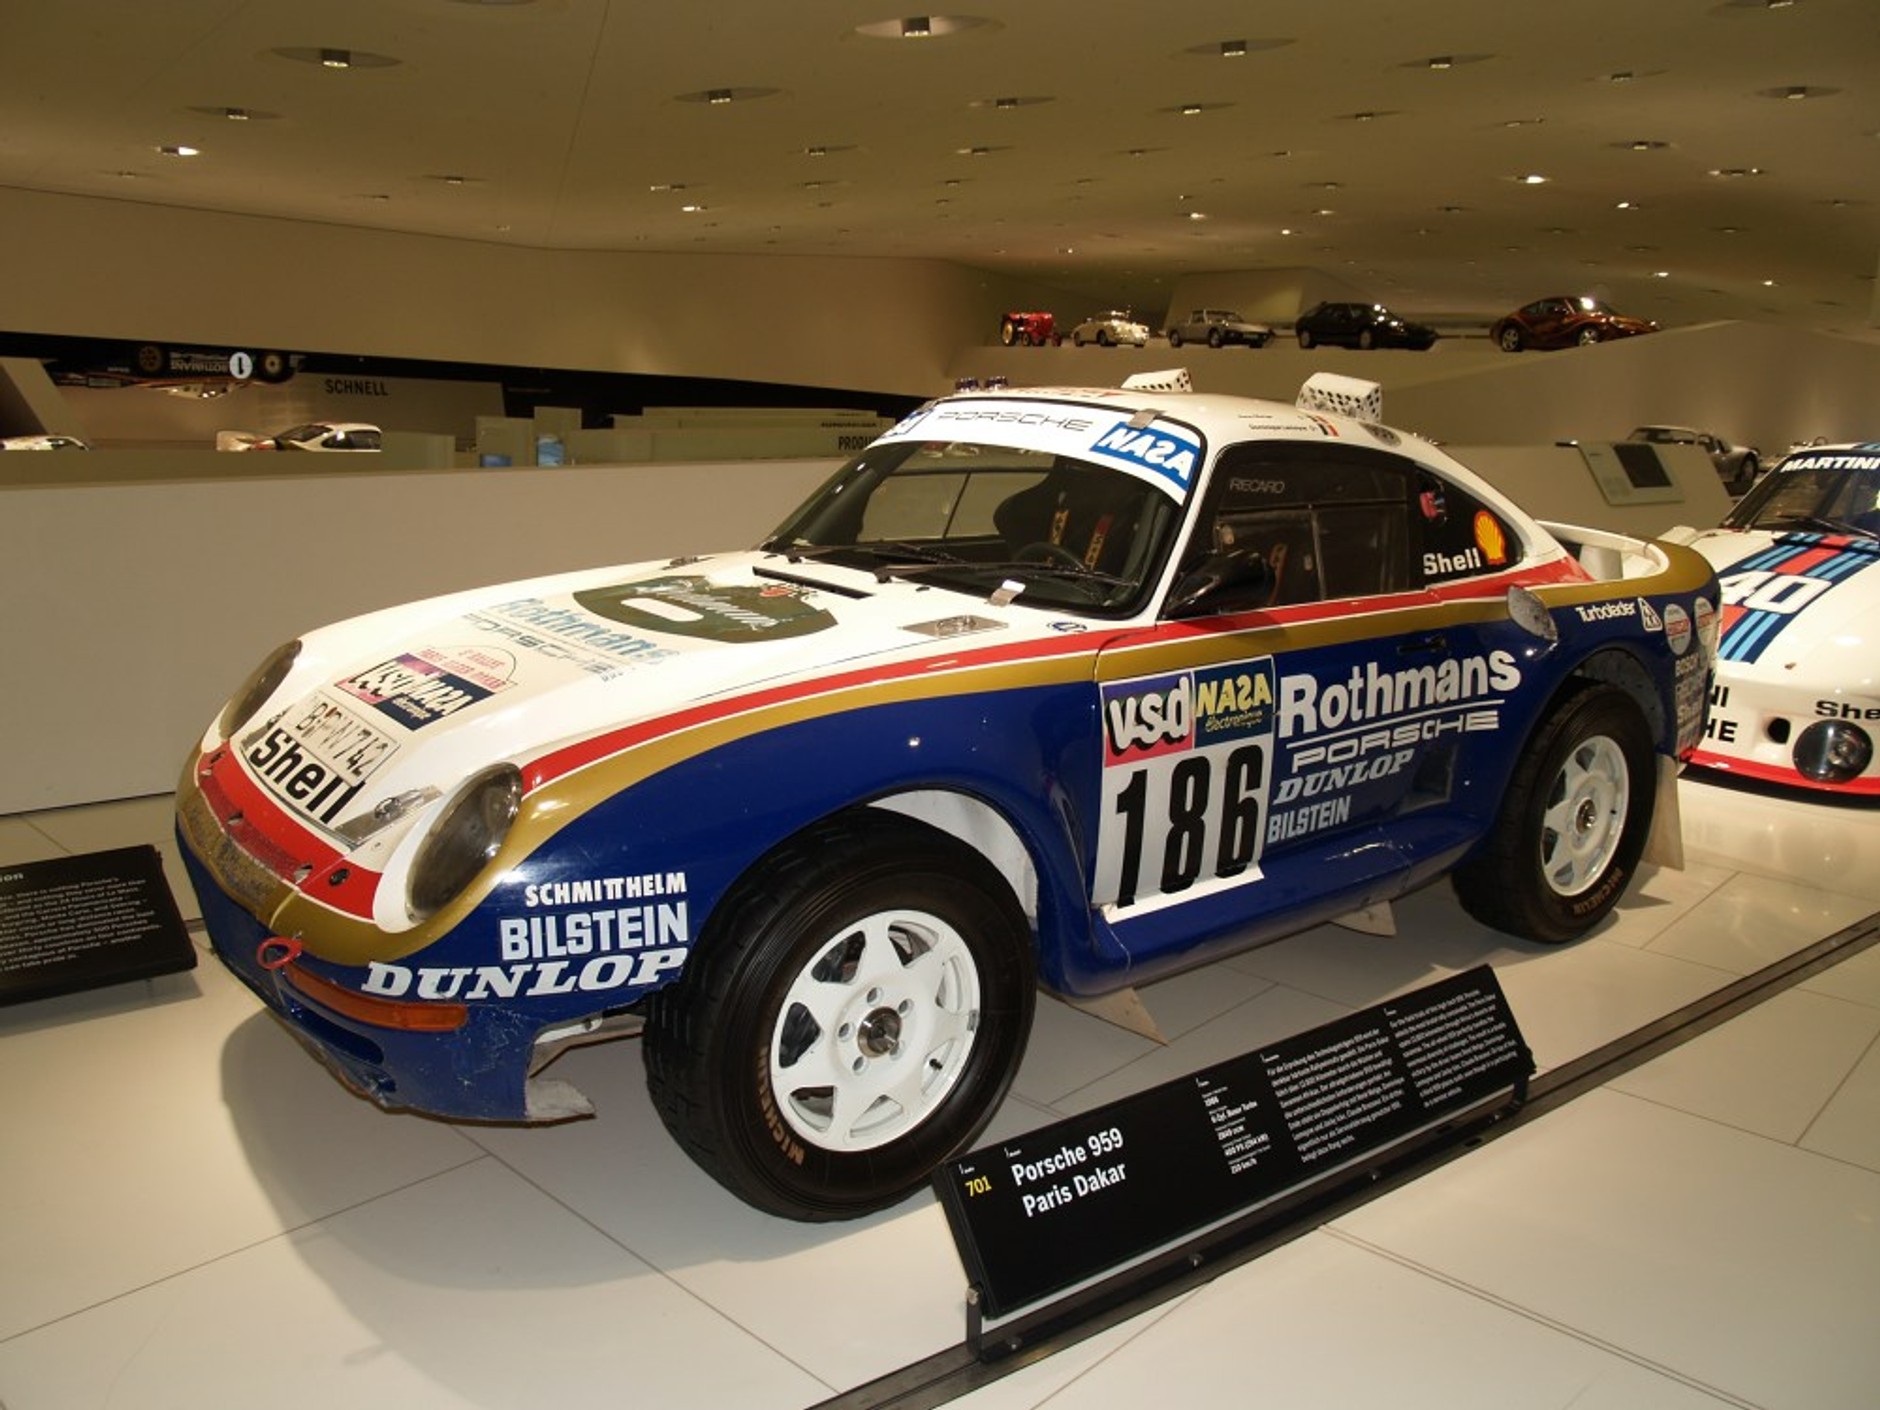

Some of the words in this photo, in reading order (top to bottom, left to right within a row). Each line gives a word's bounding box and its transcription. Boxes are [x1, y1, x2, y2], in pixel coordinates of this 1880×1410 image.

[324, 378, 389, 396] SCHNELL
[937, 411, 1094, 432] PORSCHE
[1229, 477, 1286, 495] RECARO
[1423, 547, 1482, 576] Shell
[496, 597, 681, 665] Rothmans
[1575, 600, 1636, 623] Turbolader
[1279, 650, 1521, 739] Rothmans
[1292, 710, 1499, 774] PORSCHE
[250, 727, 366, 825] Shell
[1273, 749, 1415, 805] DUNLOP
[1116, 744, 1264, 909] 186
[1267, 795, 1351, 844] BILSTEIN
[500, 901, 688, 961] BILSTEIN
[361, 948, 687, 999] DUNLOP
[758, 1045, 805, 1166] MICHELIN
[1011, 1146, 1086, 1187] Porsche
[1087, 1127, 1124, 1157] 959
[965, 1175, 992, 1197] 701
[1022, 1184, 1073, 1218] Paris
[1072, 1163, 1126, 1197] Dakar
